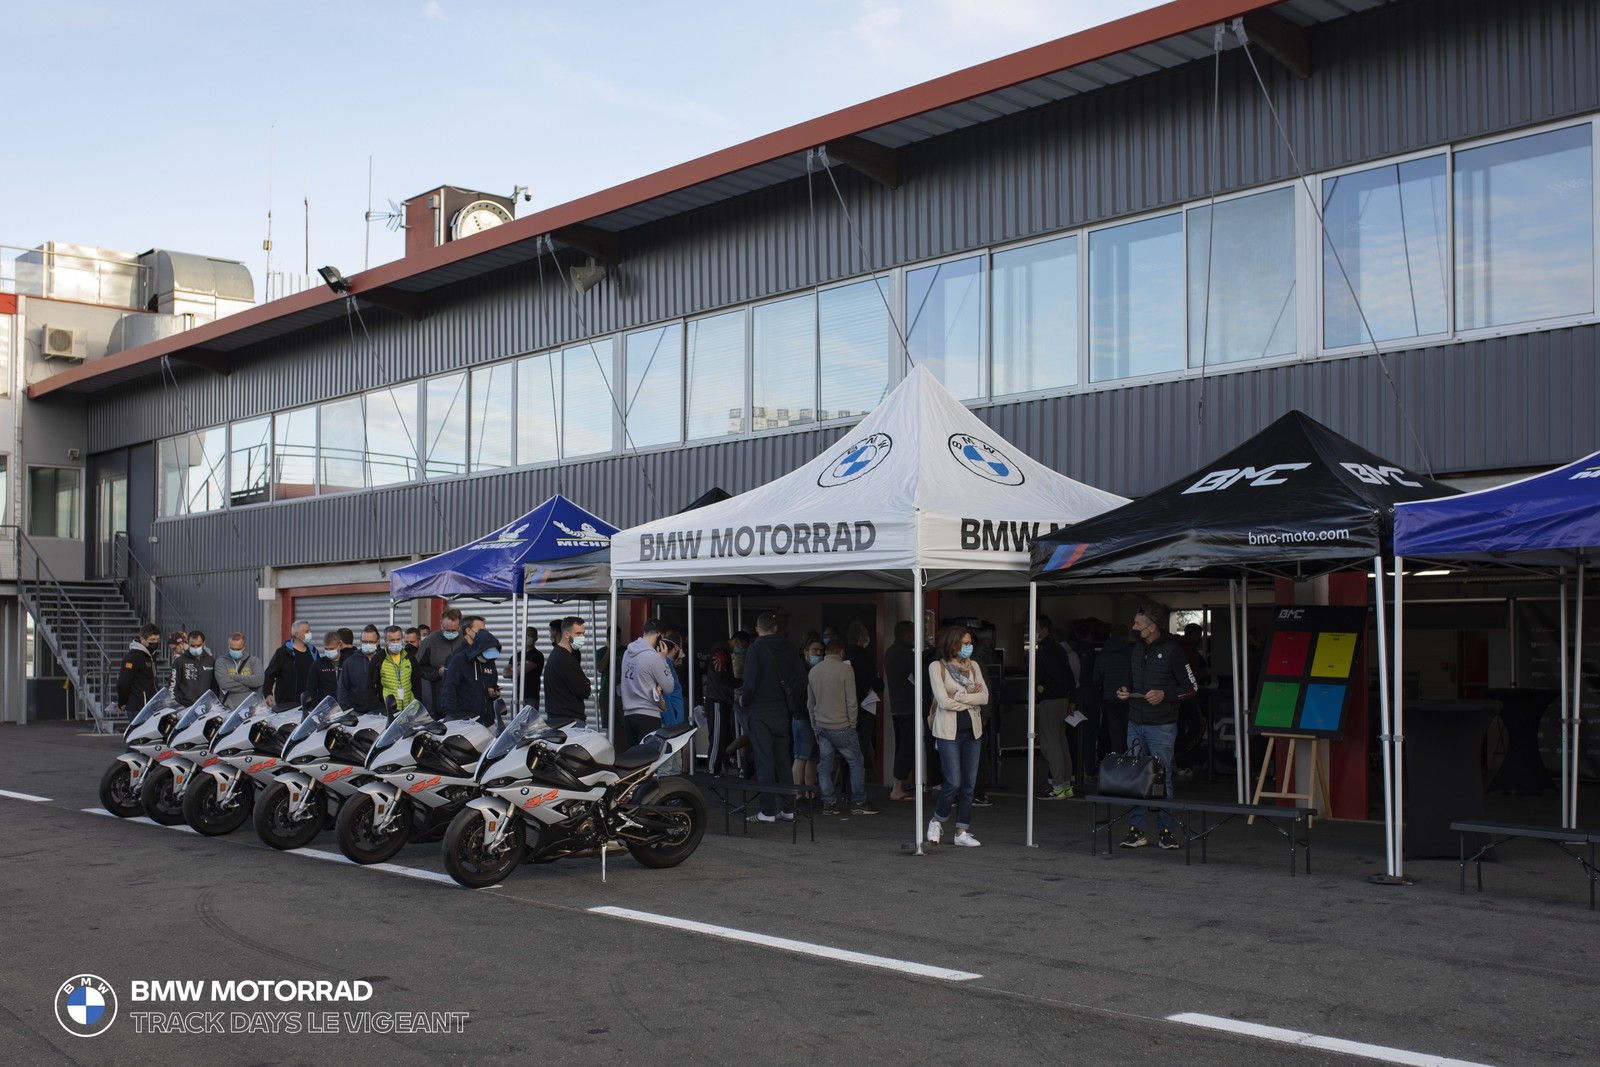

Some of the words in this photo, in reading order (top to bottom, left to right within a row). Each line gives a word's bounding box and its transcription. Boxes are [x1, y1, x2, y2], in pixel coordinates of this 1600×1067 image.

[952, 436, 995, 454] BMW
[1180, 461, 1313, 495] BMC
[1339, 461, 1424, 488] BMC
[639, 528, 703, 562] BMW
[710, 519, 877, 558] MOTORRAD
[961, 517, 1040, 552] BMW
[1248, 527, 1350, 546] bmc-moto.com
[1278, 608, 1306, 619] BMC
